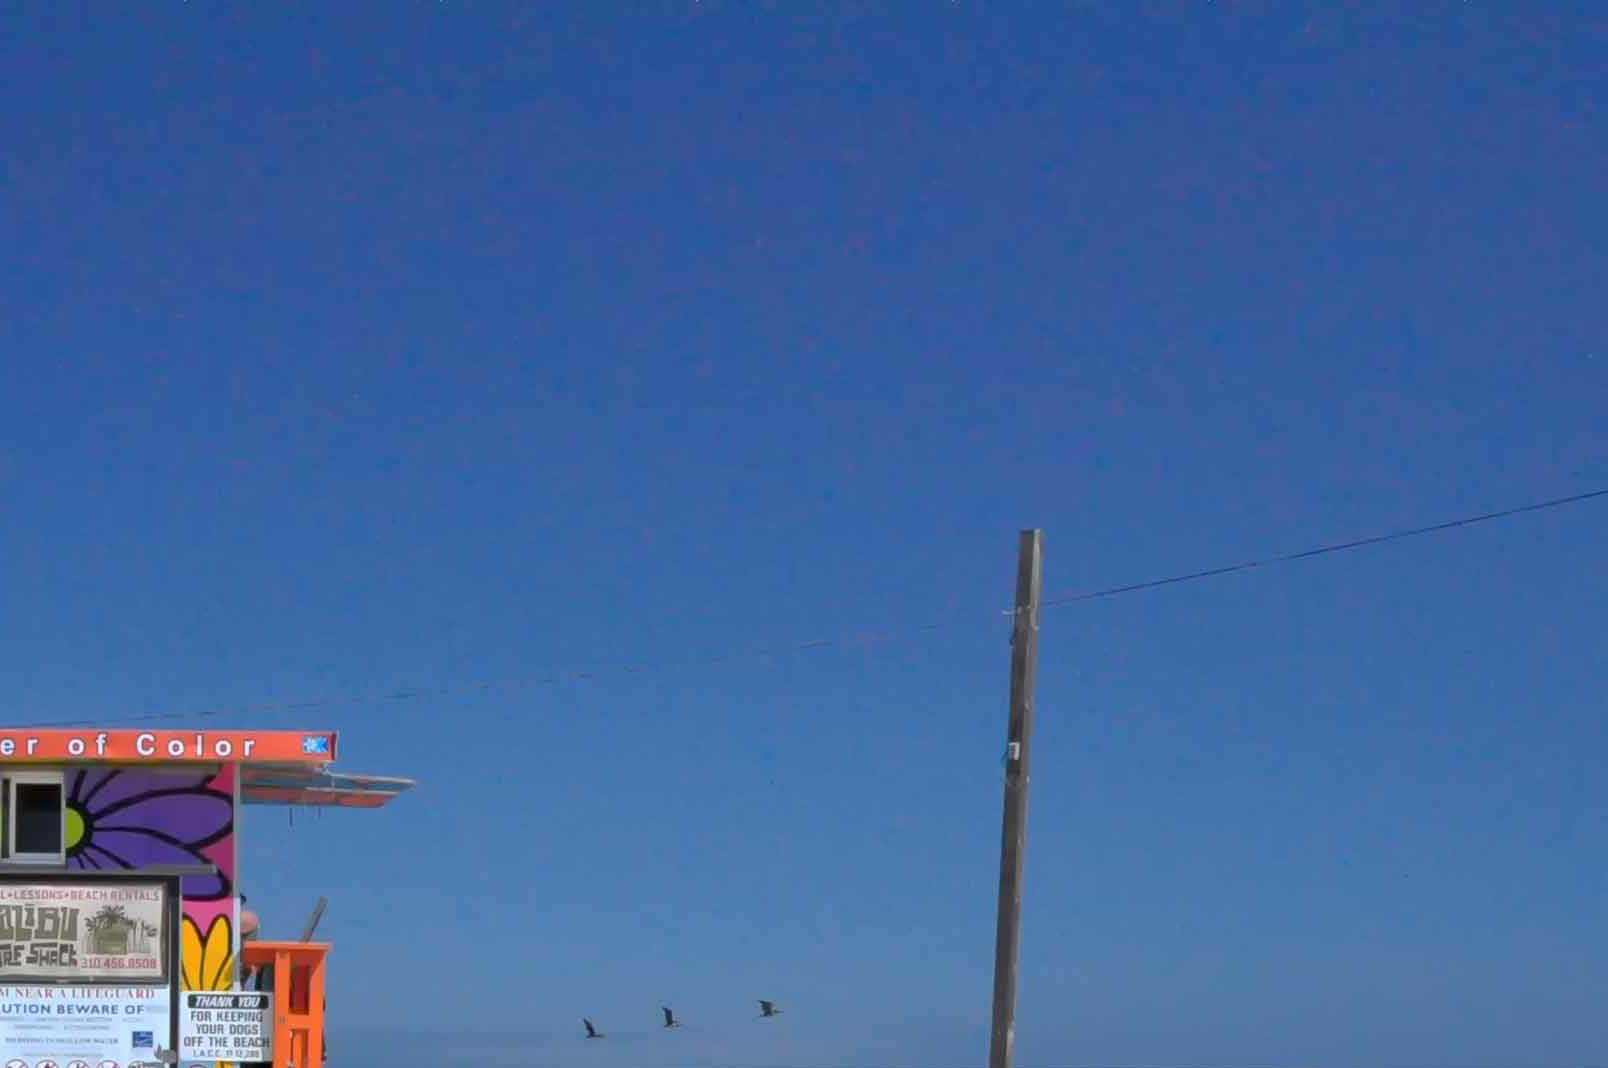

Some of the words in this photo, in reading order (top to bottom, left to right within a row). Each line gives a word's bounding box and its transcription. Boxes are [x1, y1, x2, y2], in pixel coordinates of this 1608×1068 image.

[68, 733, 109, 756] of
[135, 734, 255, 757] Color
[111, 889, 160, 901] RENTALS
[16, 987, 53, 999] NEAR
[59, 988, 67, 999] A
[72, 988, 155, 1000] LIFEGUARD
[195, 995, 234, 1007] THANK
[238, 995, 261, 1007] YOU
[57, 1004, 119, 1015] BEWARE
[124, 1004, 145, 1015] OF
[190, 1011, 212, 1022] FOR
[217, 1011, 263, 1022] KEEPING
[196, 1024, 224, 1034] YOUR
[229, 1024, 259, 1035] DOGS
[183, 1036, 203, 1047] OFF
[208, 1037, 229, 1047] THE
[233, 1037, 270, 1048] BEACH
